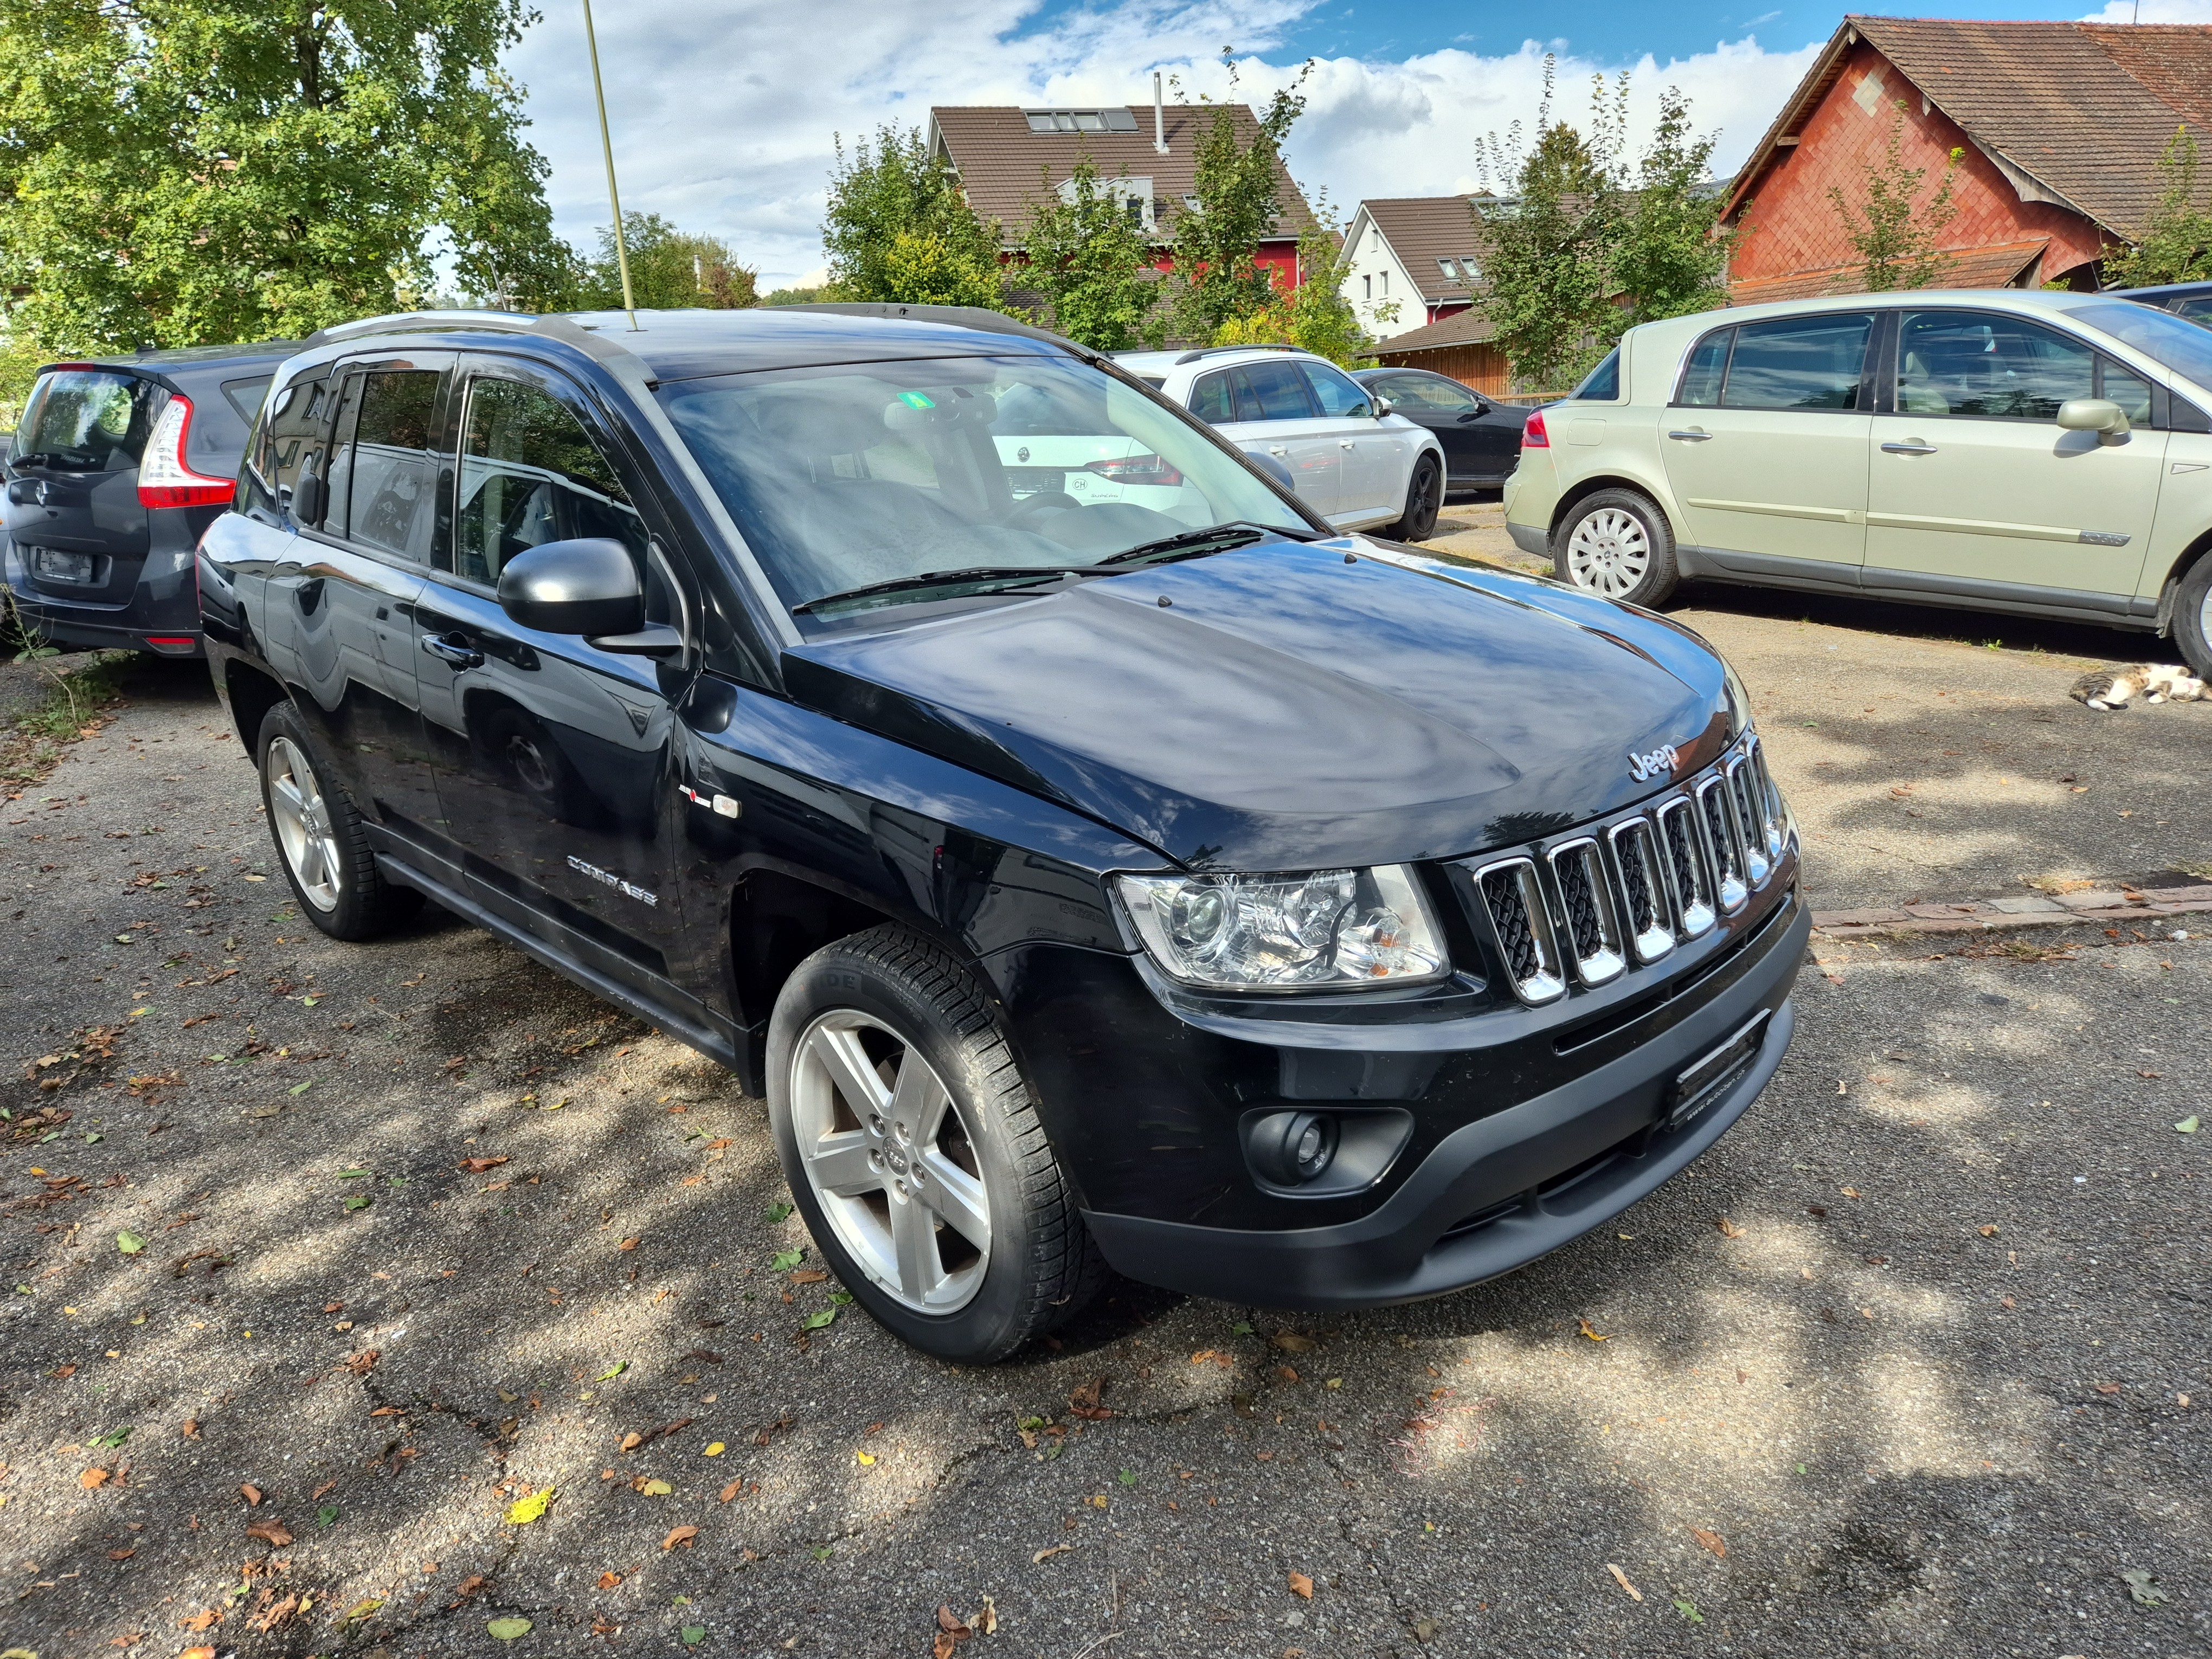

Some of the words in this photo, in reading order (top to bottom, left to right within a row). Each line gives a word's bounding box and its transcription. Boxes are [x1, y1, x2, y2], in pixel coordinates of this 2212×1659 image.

[1074, 480, 1085, 489] CH
[1627, 744, 1680, 783] Jeep
[567, 855, 658, 907] COMPASS
